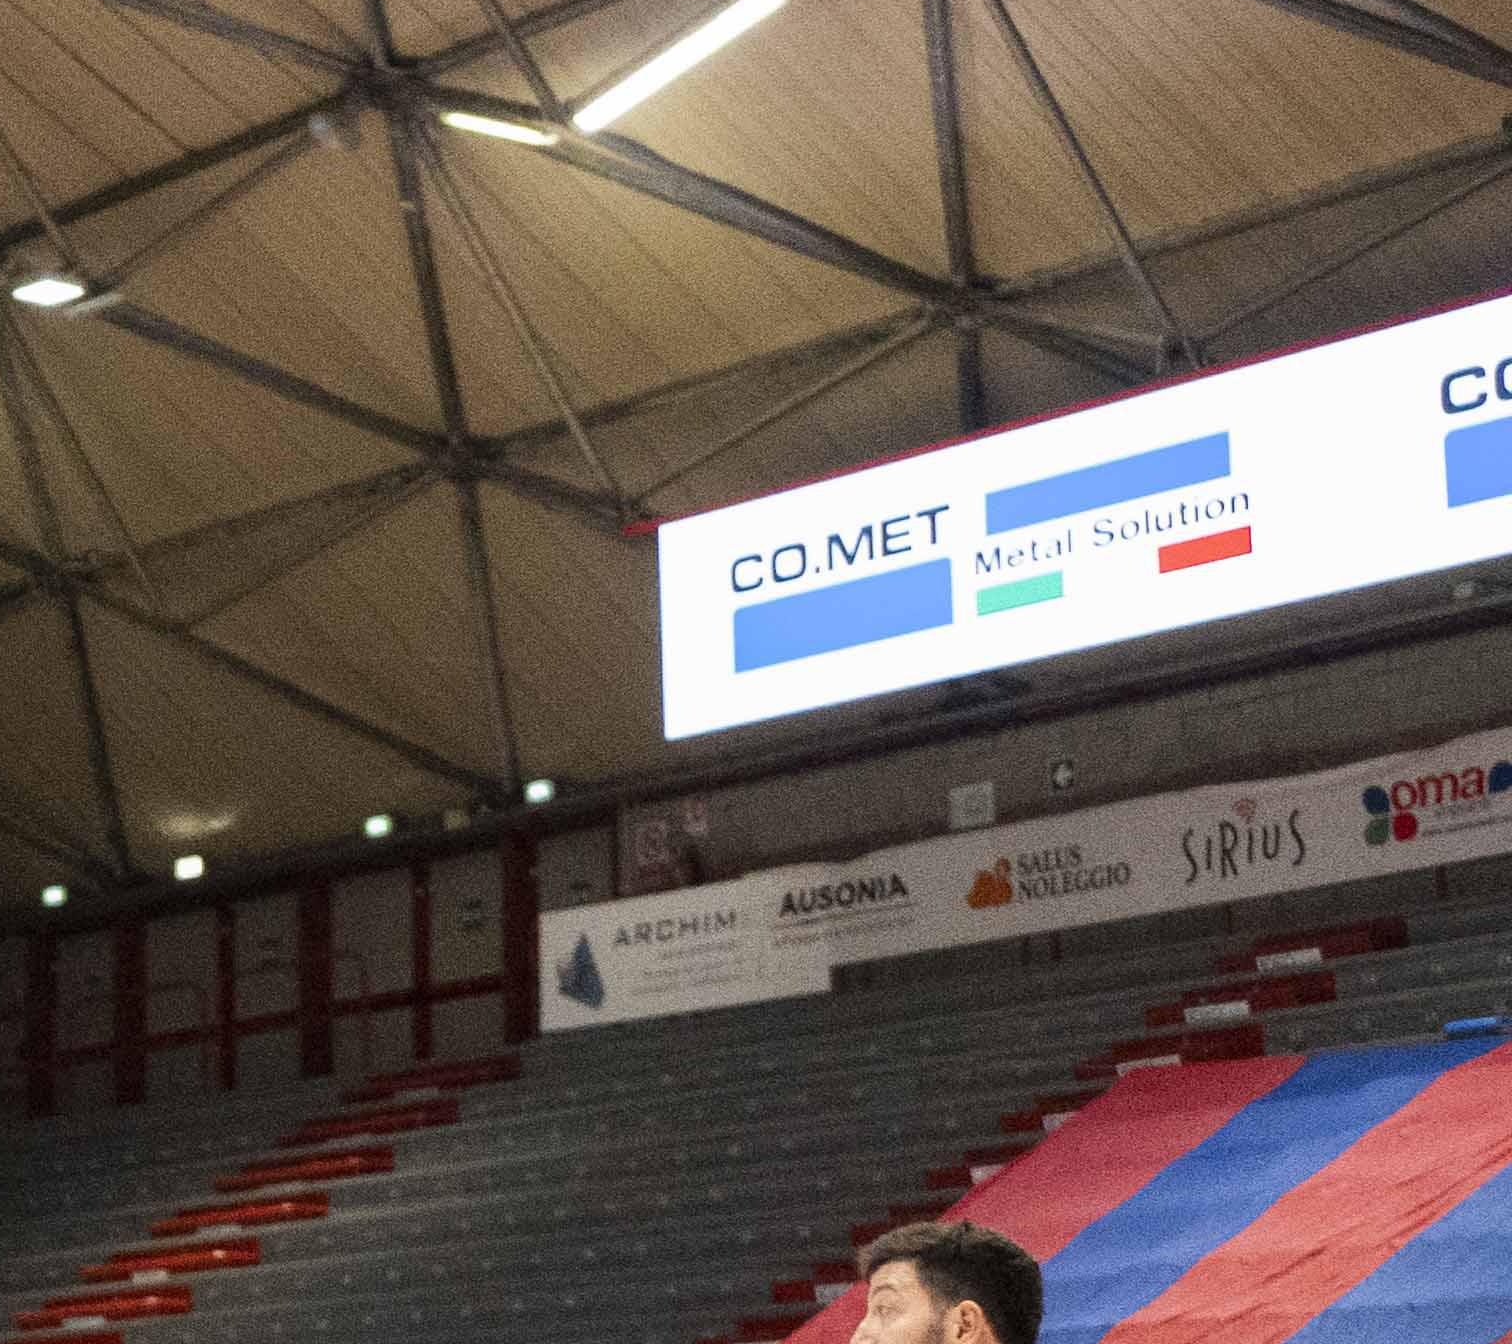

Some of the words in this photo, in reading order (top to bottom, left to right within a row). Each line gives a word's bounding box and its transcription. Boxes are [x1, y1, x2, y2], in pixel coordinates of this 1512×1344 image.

[728, 504, 952, 596] CO.MET
[974, 530, 1076, 577] Metal
[1093, 486, 1252, 549] Solution
[1392, 763, 1485, 813] oma
[1016, 844, 1083, 876] SALUS
[1016, 860, 1132, 903] NOLEGGIO
[777, 873, 909, 920] AUSONIA
[613, 908, 738, 950] ARCHIM
